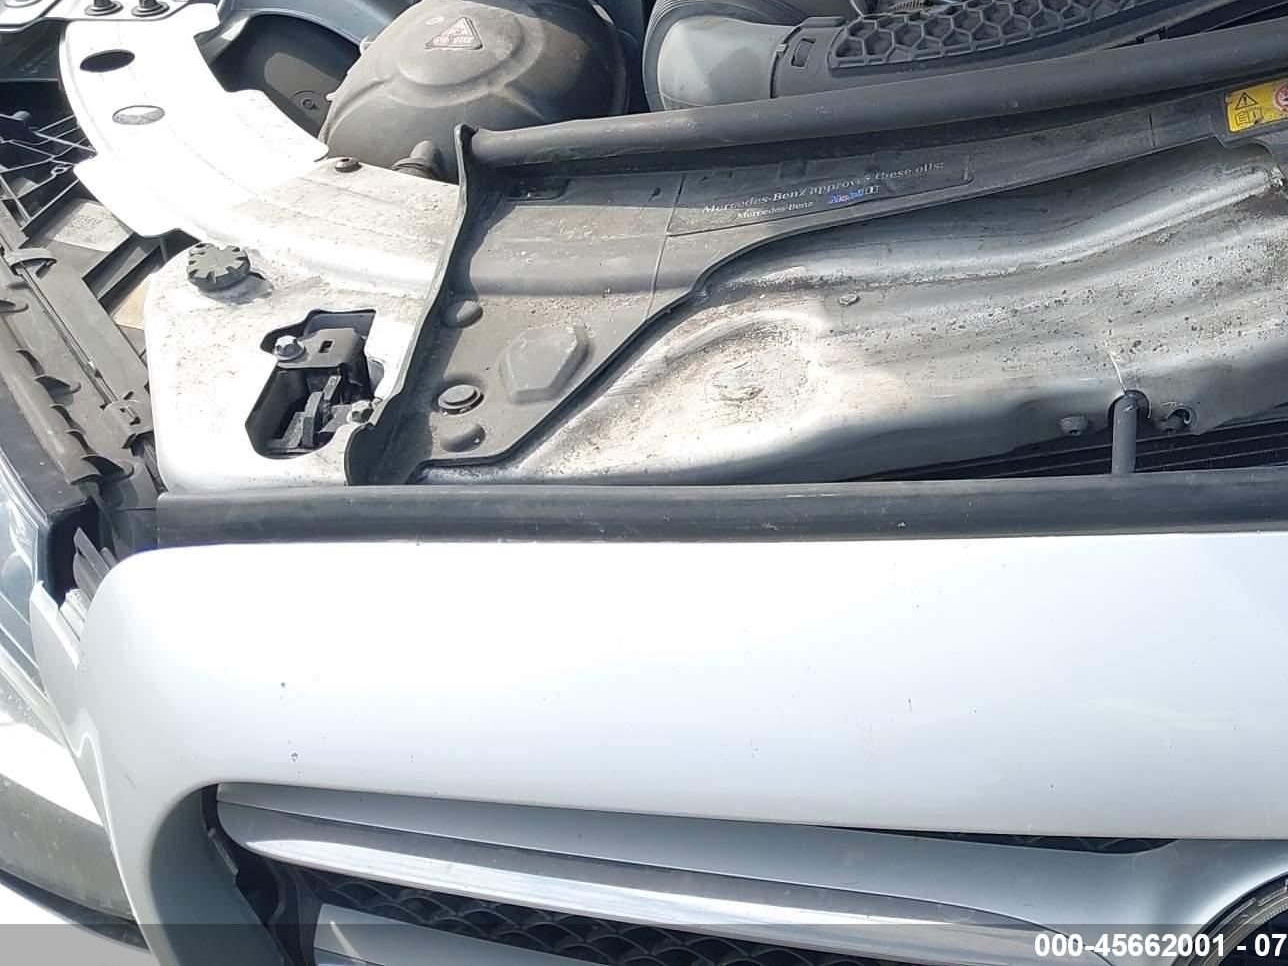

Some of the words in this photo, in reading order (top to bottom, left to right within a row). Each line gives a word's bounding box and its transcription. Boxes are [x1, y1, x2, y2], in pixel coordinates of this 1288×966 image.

[701, 187, 808, 214] Mercedes-Benz
[874, 168, 913, 180] these
[736, 200, 815, 220] Mercedes-Benz
